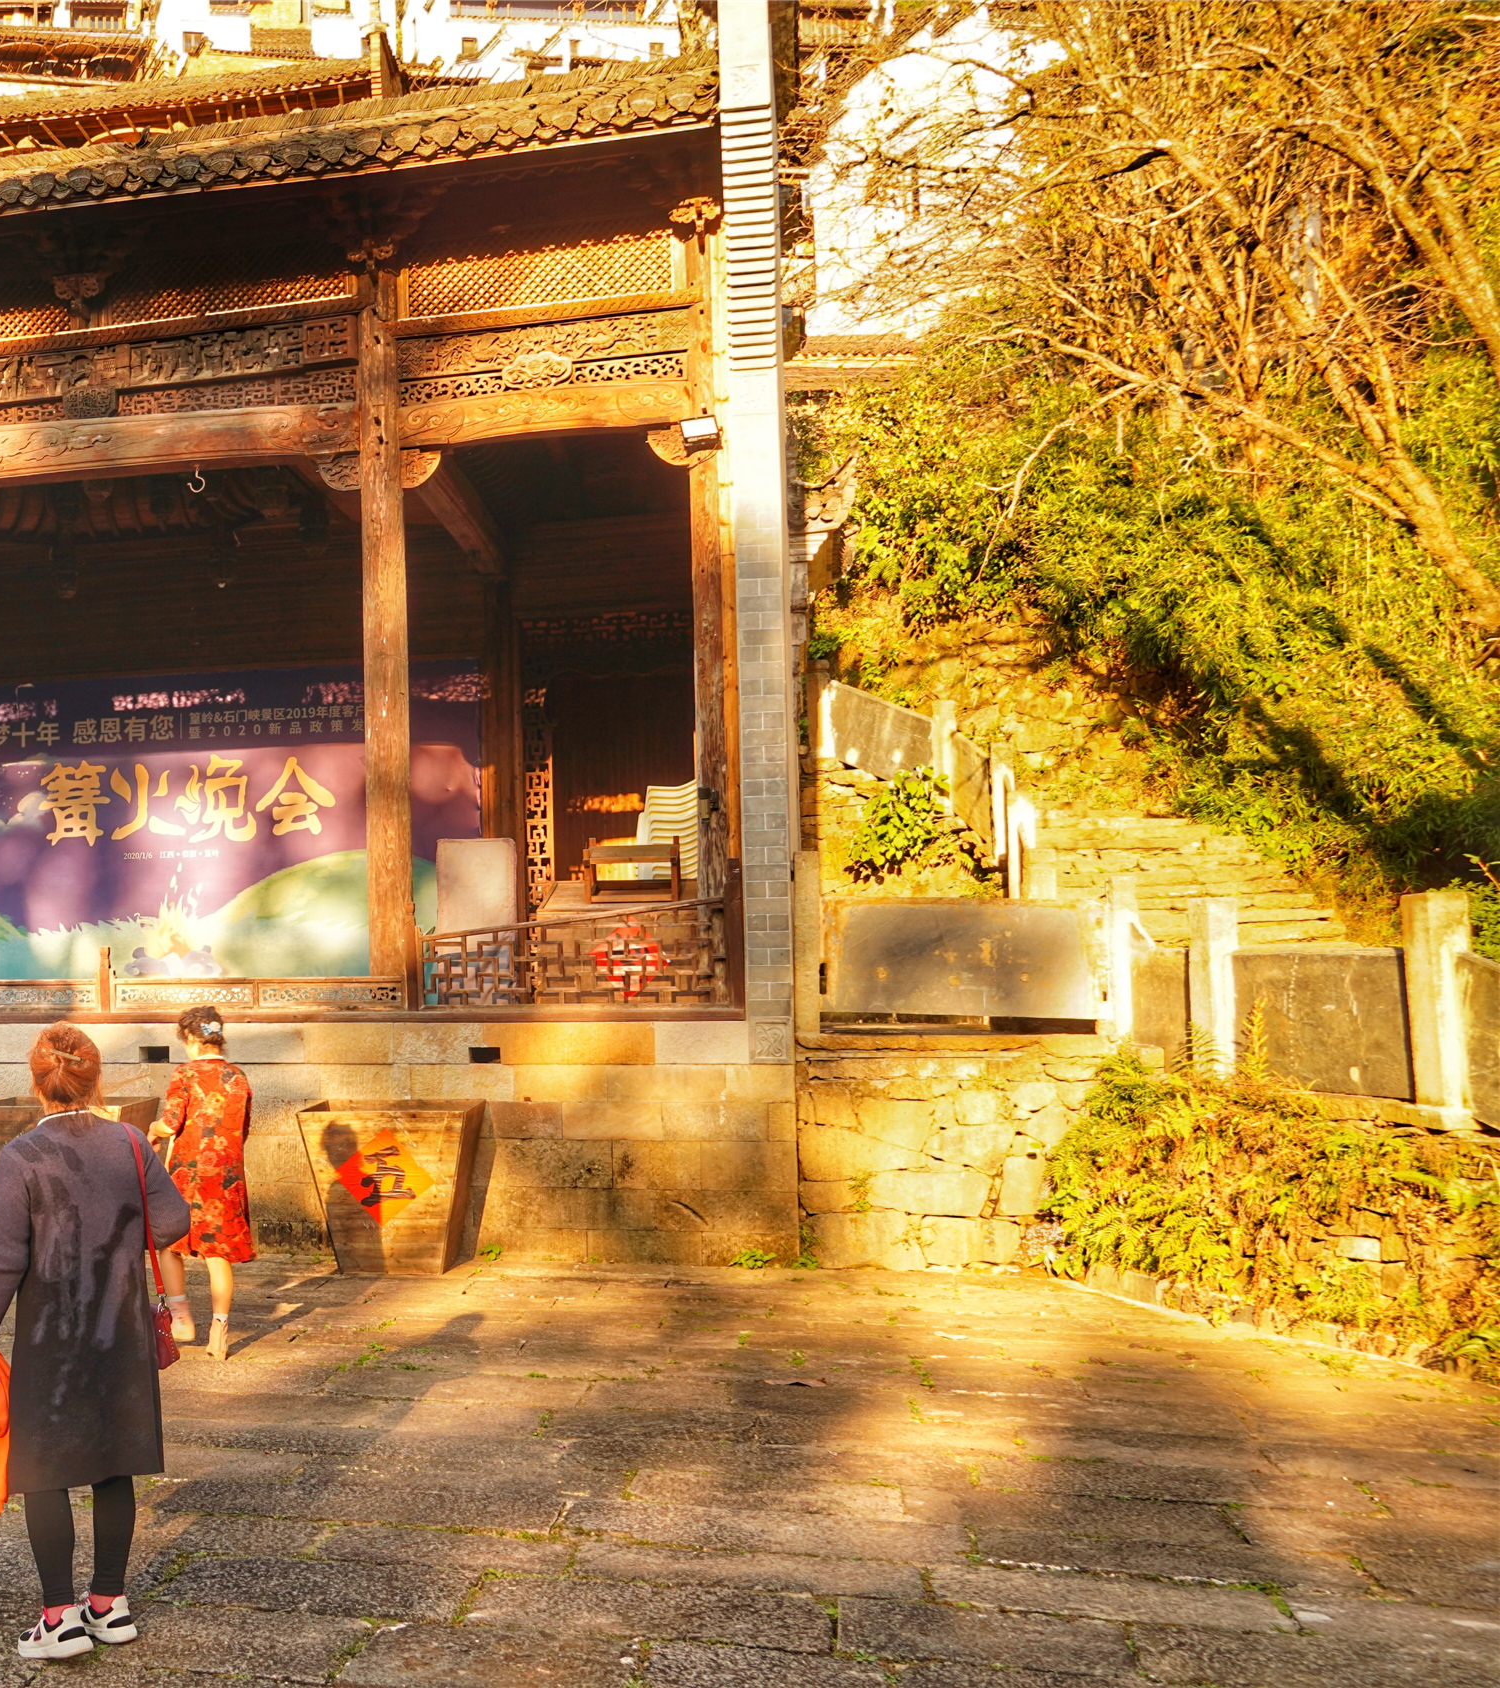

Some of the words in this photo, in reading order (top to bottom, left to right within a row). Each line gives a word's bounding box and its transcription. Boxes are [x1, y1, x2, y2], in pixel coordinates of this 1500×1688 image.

[73, 714, 175, 744] 感恩有您
[38, 754, 336, 847] 篝火晚会
[123, 851, 153, 860] 2020/1/6
[361, 1145, 417, 1207] 五
